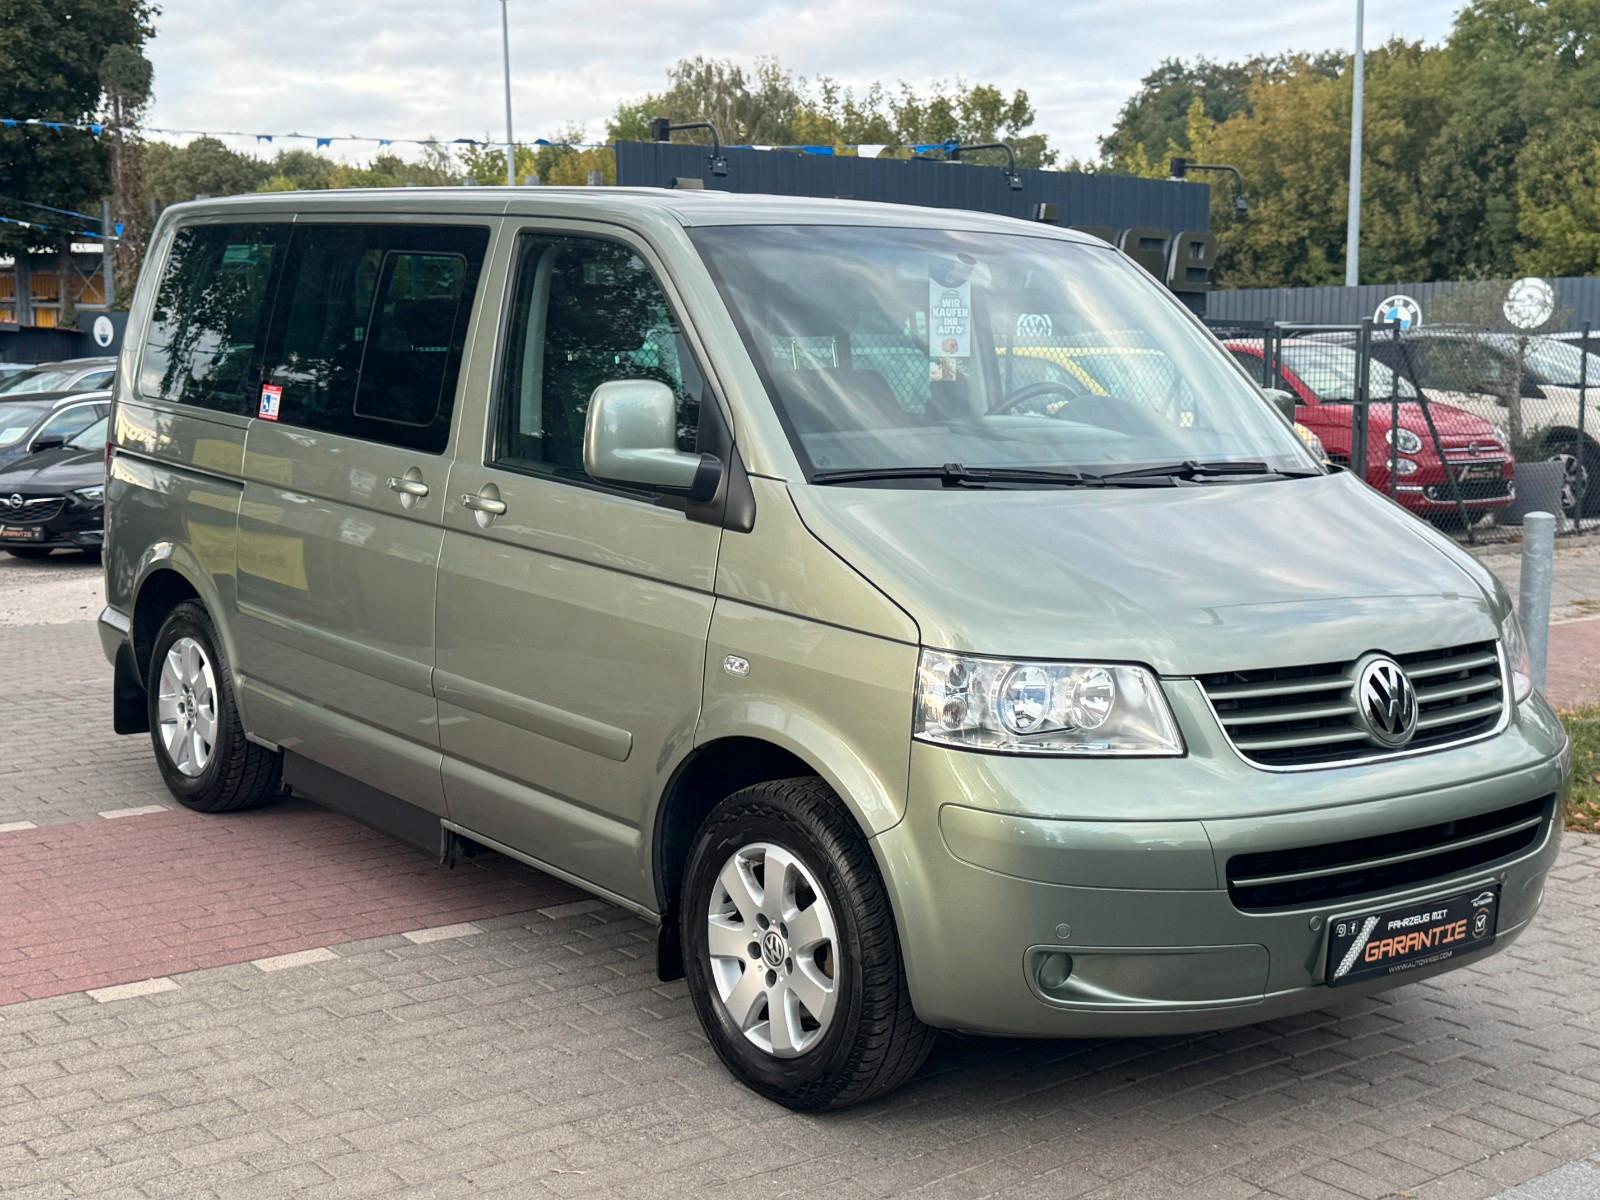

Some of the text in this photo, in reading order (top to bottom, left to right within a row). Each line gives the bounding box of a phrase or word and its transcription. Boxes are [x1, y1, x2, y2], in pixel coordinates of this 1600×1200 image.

[942, 298, 960, 308] WIR
[1380, 299, 1417, 314] BMW
[932, 307, 969, 318] KAUFEN
[943, 317, 959, 326] IHR
[1361, 660, 1414, 743] VW
[1387, 909, 1449, 931] FAHRZEUG MIT
[1364, 919, 1468, 962] GARANTIE
